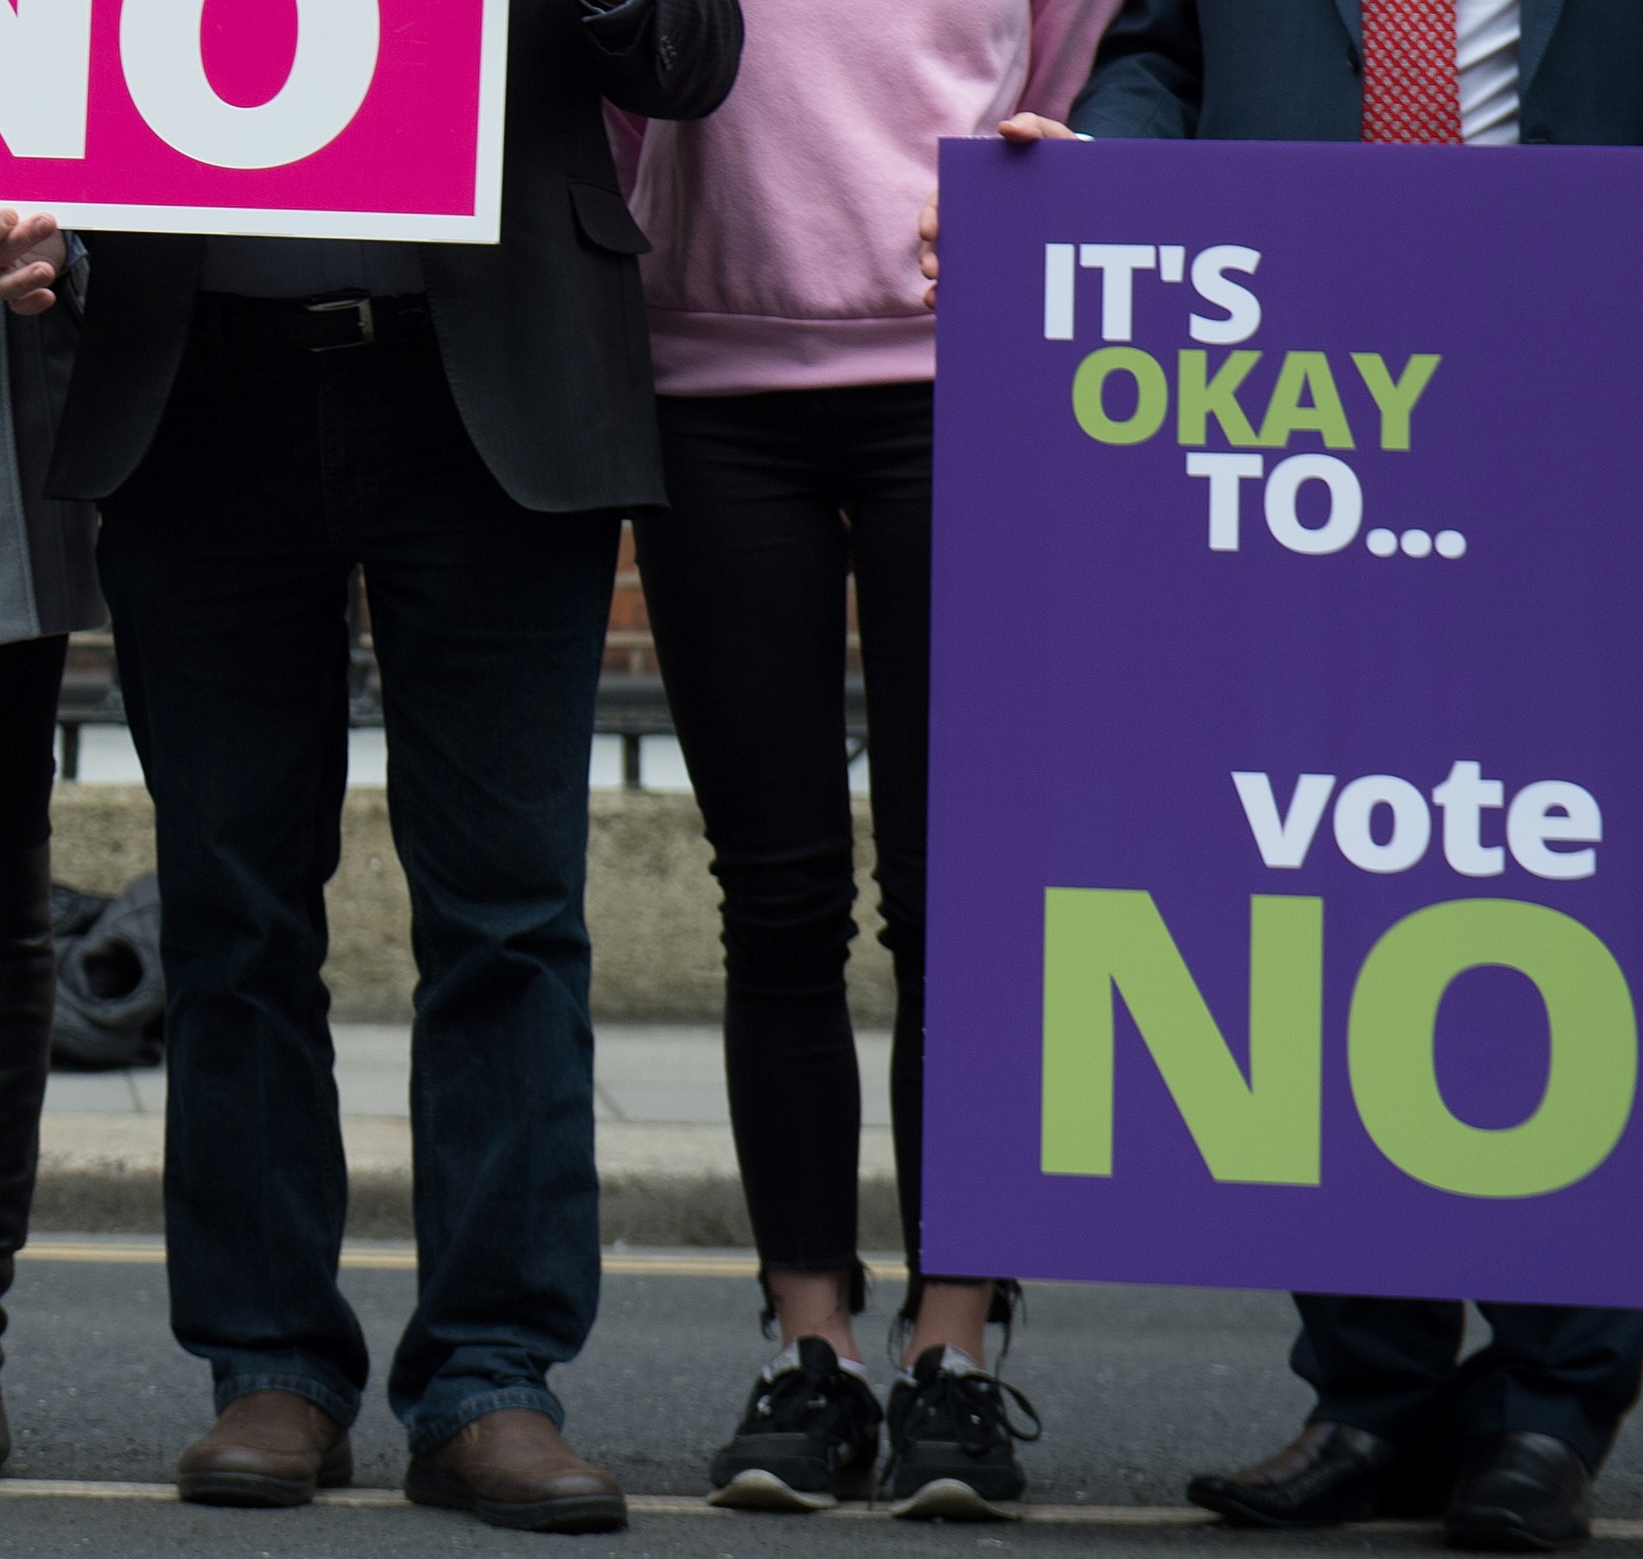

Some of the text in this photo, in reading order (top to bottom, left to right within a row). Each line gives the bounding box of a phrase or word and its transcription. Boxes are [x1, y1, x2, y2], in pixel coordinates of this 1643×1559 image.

[1043, 242, 1261, 346] IT'S
[1072, 346, 1442, 451] OKAY
[1185, 452, 1468, 559] TO...
[1230, 760, 1603, 881] vote
[1040, 886, 1639, 1200] NO
